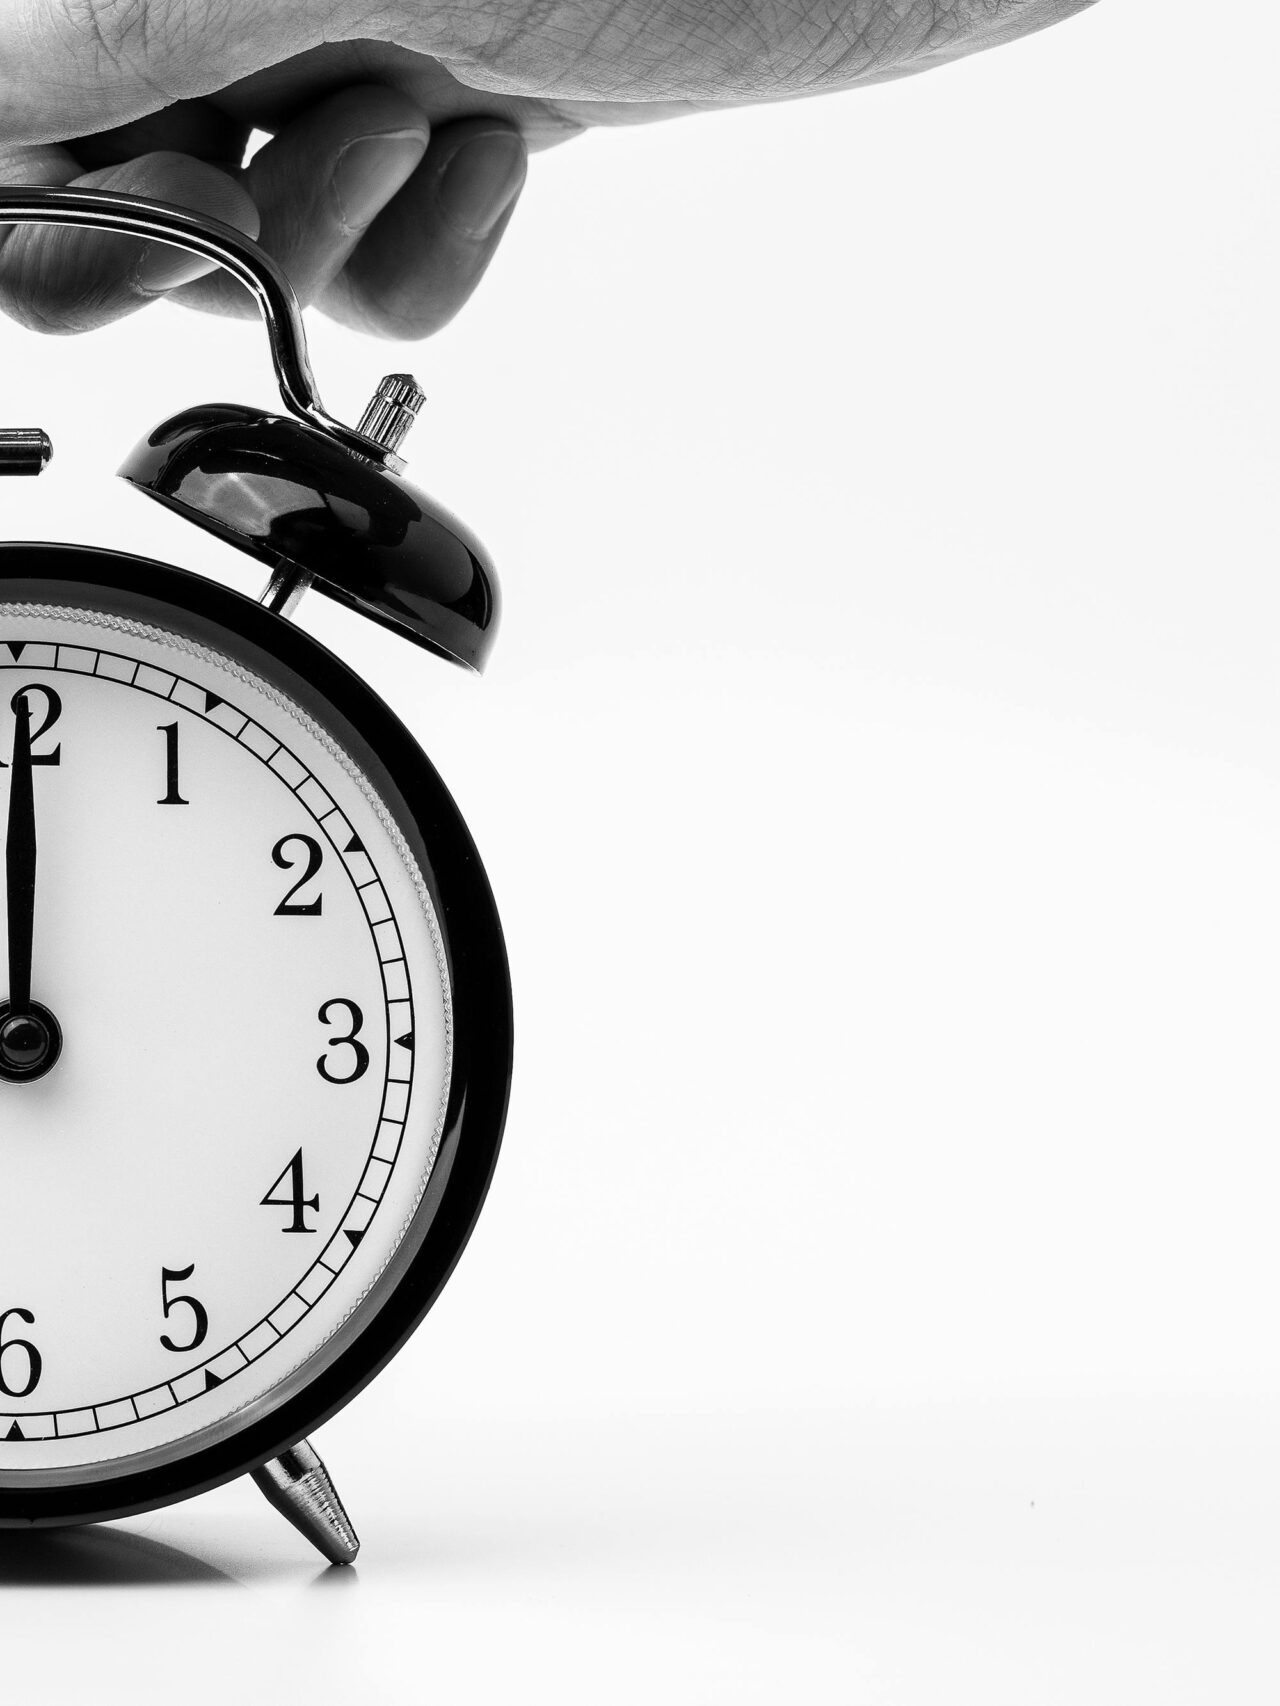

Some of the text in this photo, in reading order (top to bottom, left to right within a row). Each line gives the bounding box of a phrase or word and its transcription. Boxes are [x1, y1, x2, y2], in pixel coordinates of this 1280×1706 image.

[156, 721, 190, 805] 1
[271, 833, 324, 917] 2
[316, 997, 370, 1085] 3
[259, 1146, 320, 1234] 4
[159, 1263, 209, 1353] 5
